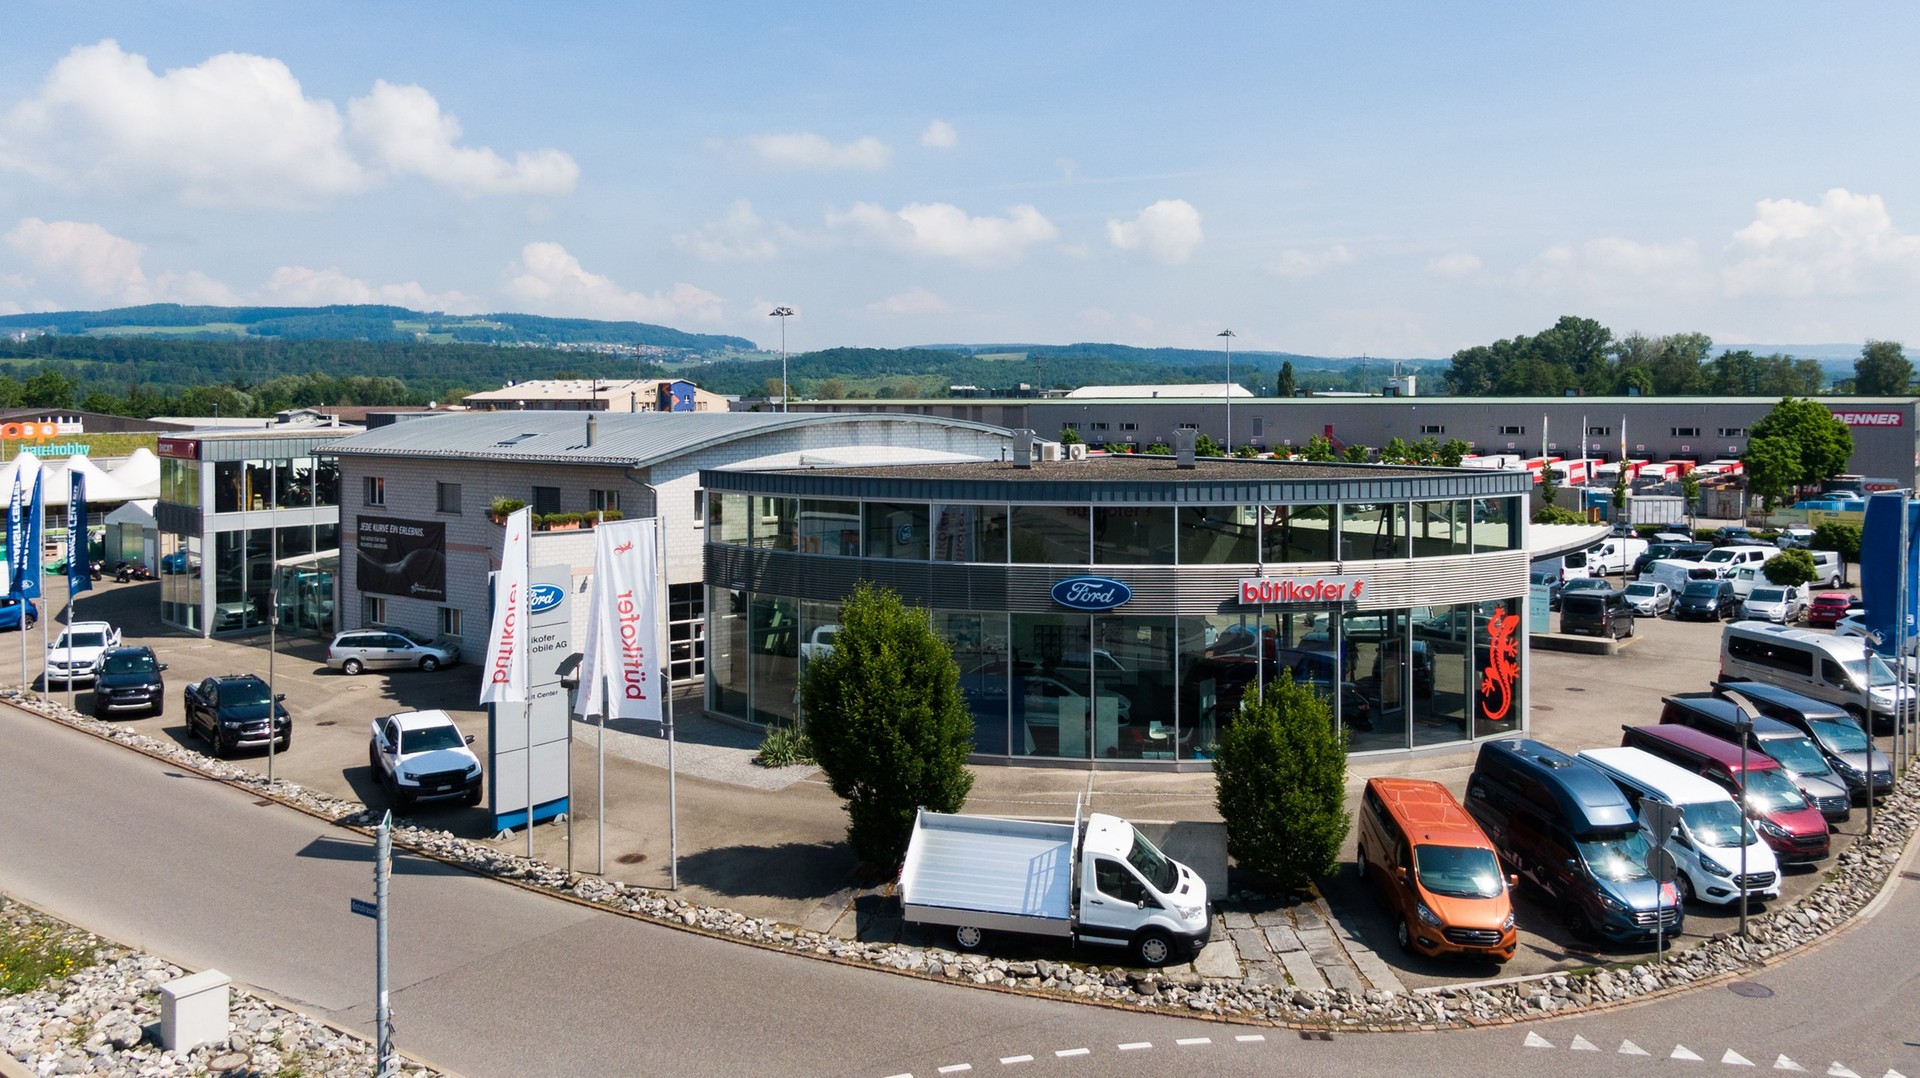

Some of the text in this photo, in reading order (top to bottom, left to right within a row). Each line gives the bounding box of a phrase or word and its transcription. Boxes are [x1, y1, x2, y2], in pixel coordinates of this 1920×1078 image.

[1831, 413, 1900, 425] DENNER
[0, 422, 59, 443] oop
[1066, 582, 1114, 603] Ford
[1242, 579, 1346, 602] bütikofer
[531, 633, 555, 644] ikofer
[532, 640, 568, 653] obile AG
[537, 690, 558, 699] Center
